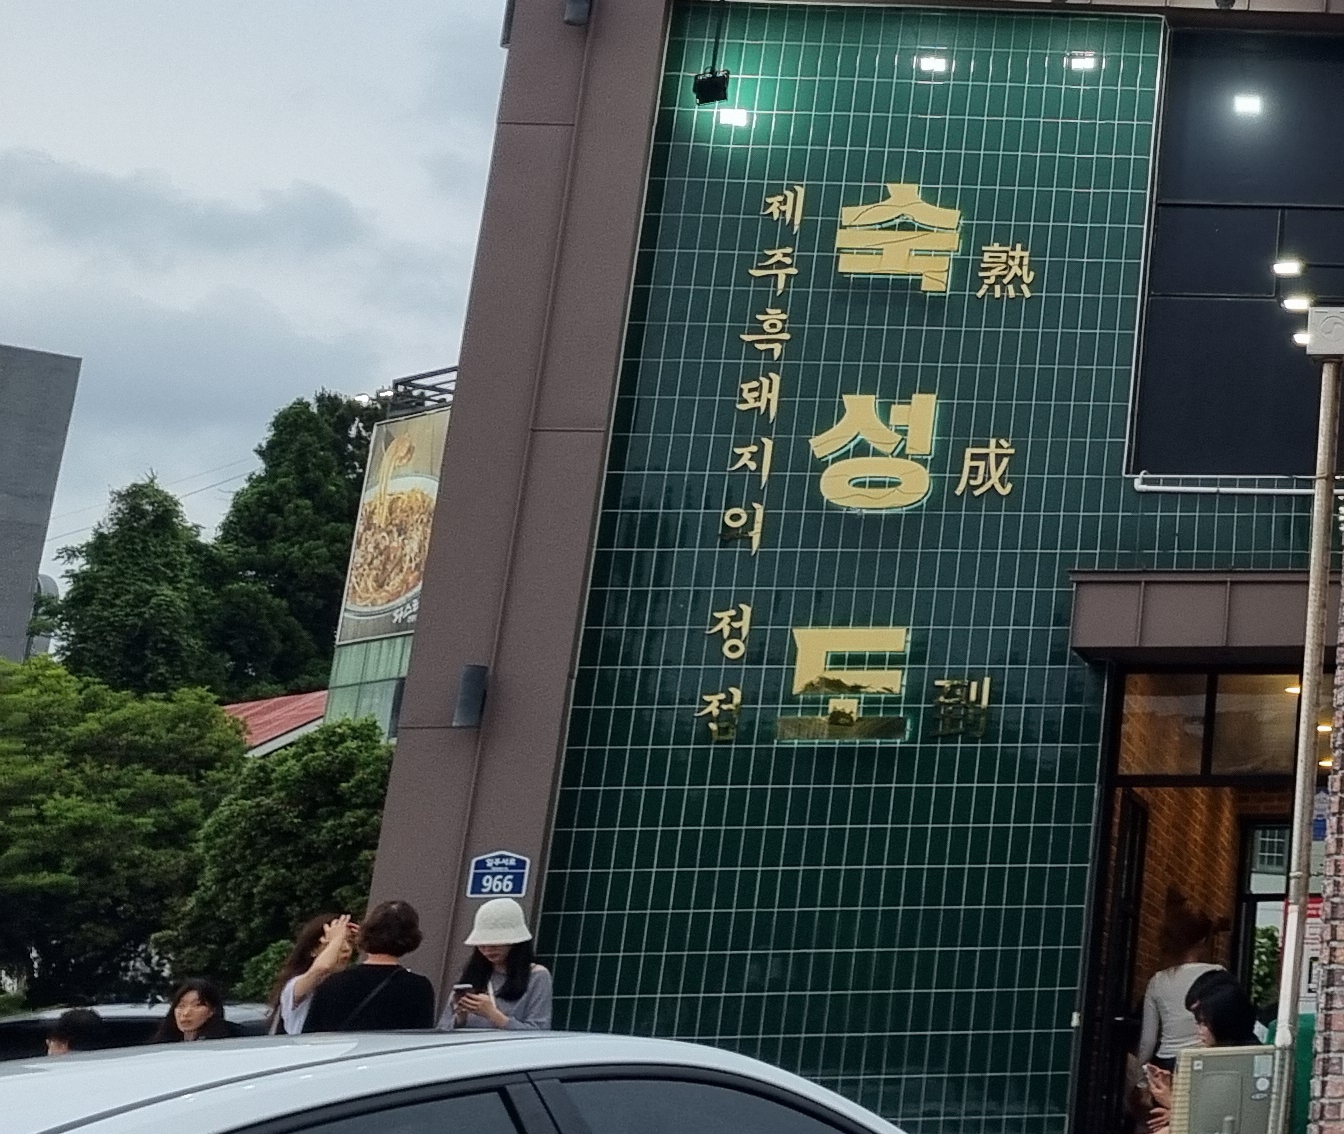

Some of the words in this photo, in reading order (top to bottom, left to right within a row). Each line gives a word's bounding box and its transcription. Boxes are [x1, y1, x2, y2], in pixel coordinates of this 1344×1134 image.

[776, 182, 962, 742] 숙성도
[694, 603, 752, 742] 정점
[481, 874, 514, 893] 966
